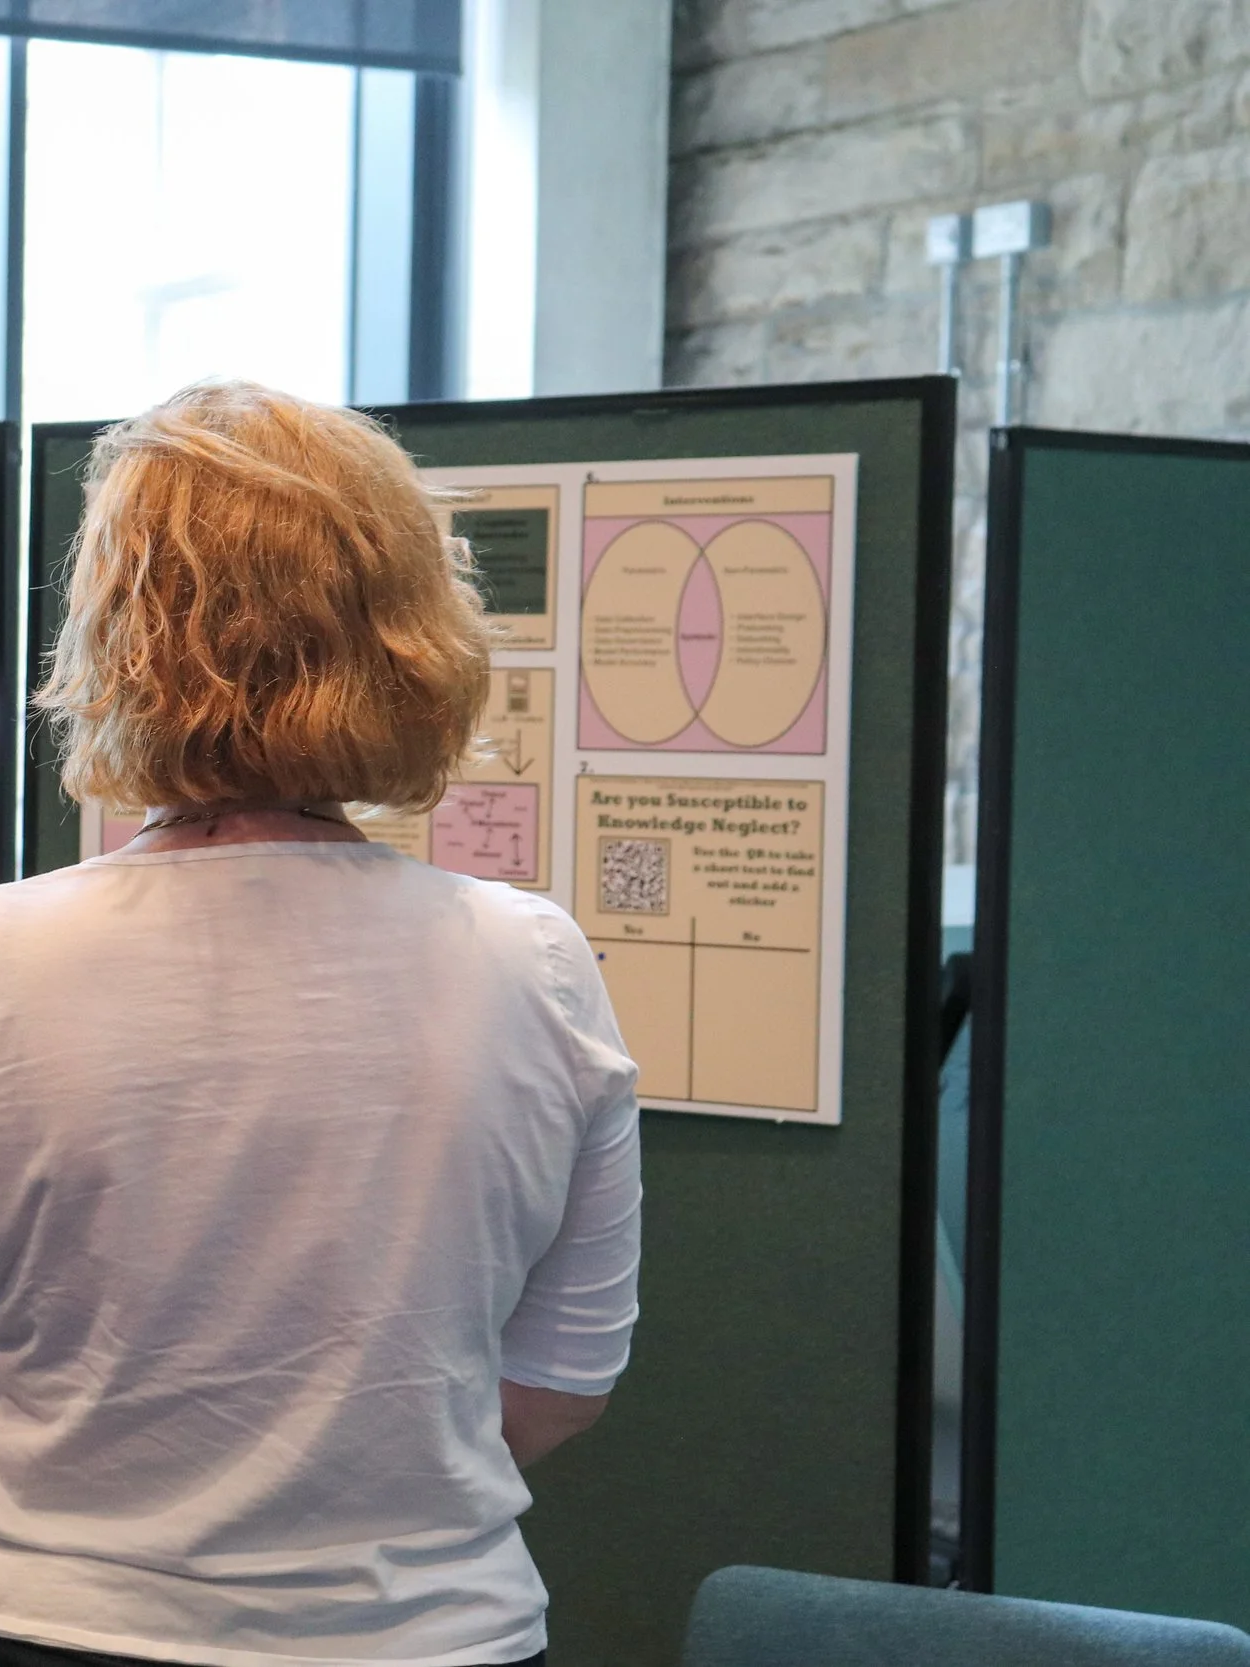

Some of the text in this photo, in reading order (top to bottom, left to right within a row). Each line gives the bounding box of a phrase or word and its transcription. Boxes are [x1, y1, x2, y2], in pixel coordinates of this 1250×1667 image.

[590, 790, 808, 813] Are you Susceptible to
[597, 814, 801, 838] Knowledge Neglect?
[693, 845, 814, 861] Use the QR to take
[693, 862, 815, 877] a short test to find
[707, 880, 730, 890] out
[733, 879, 758, 891] and
[762, 880, 788, 892] add
